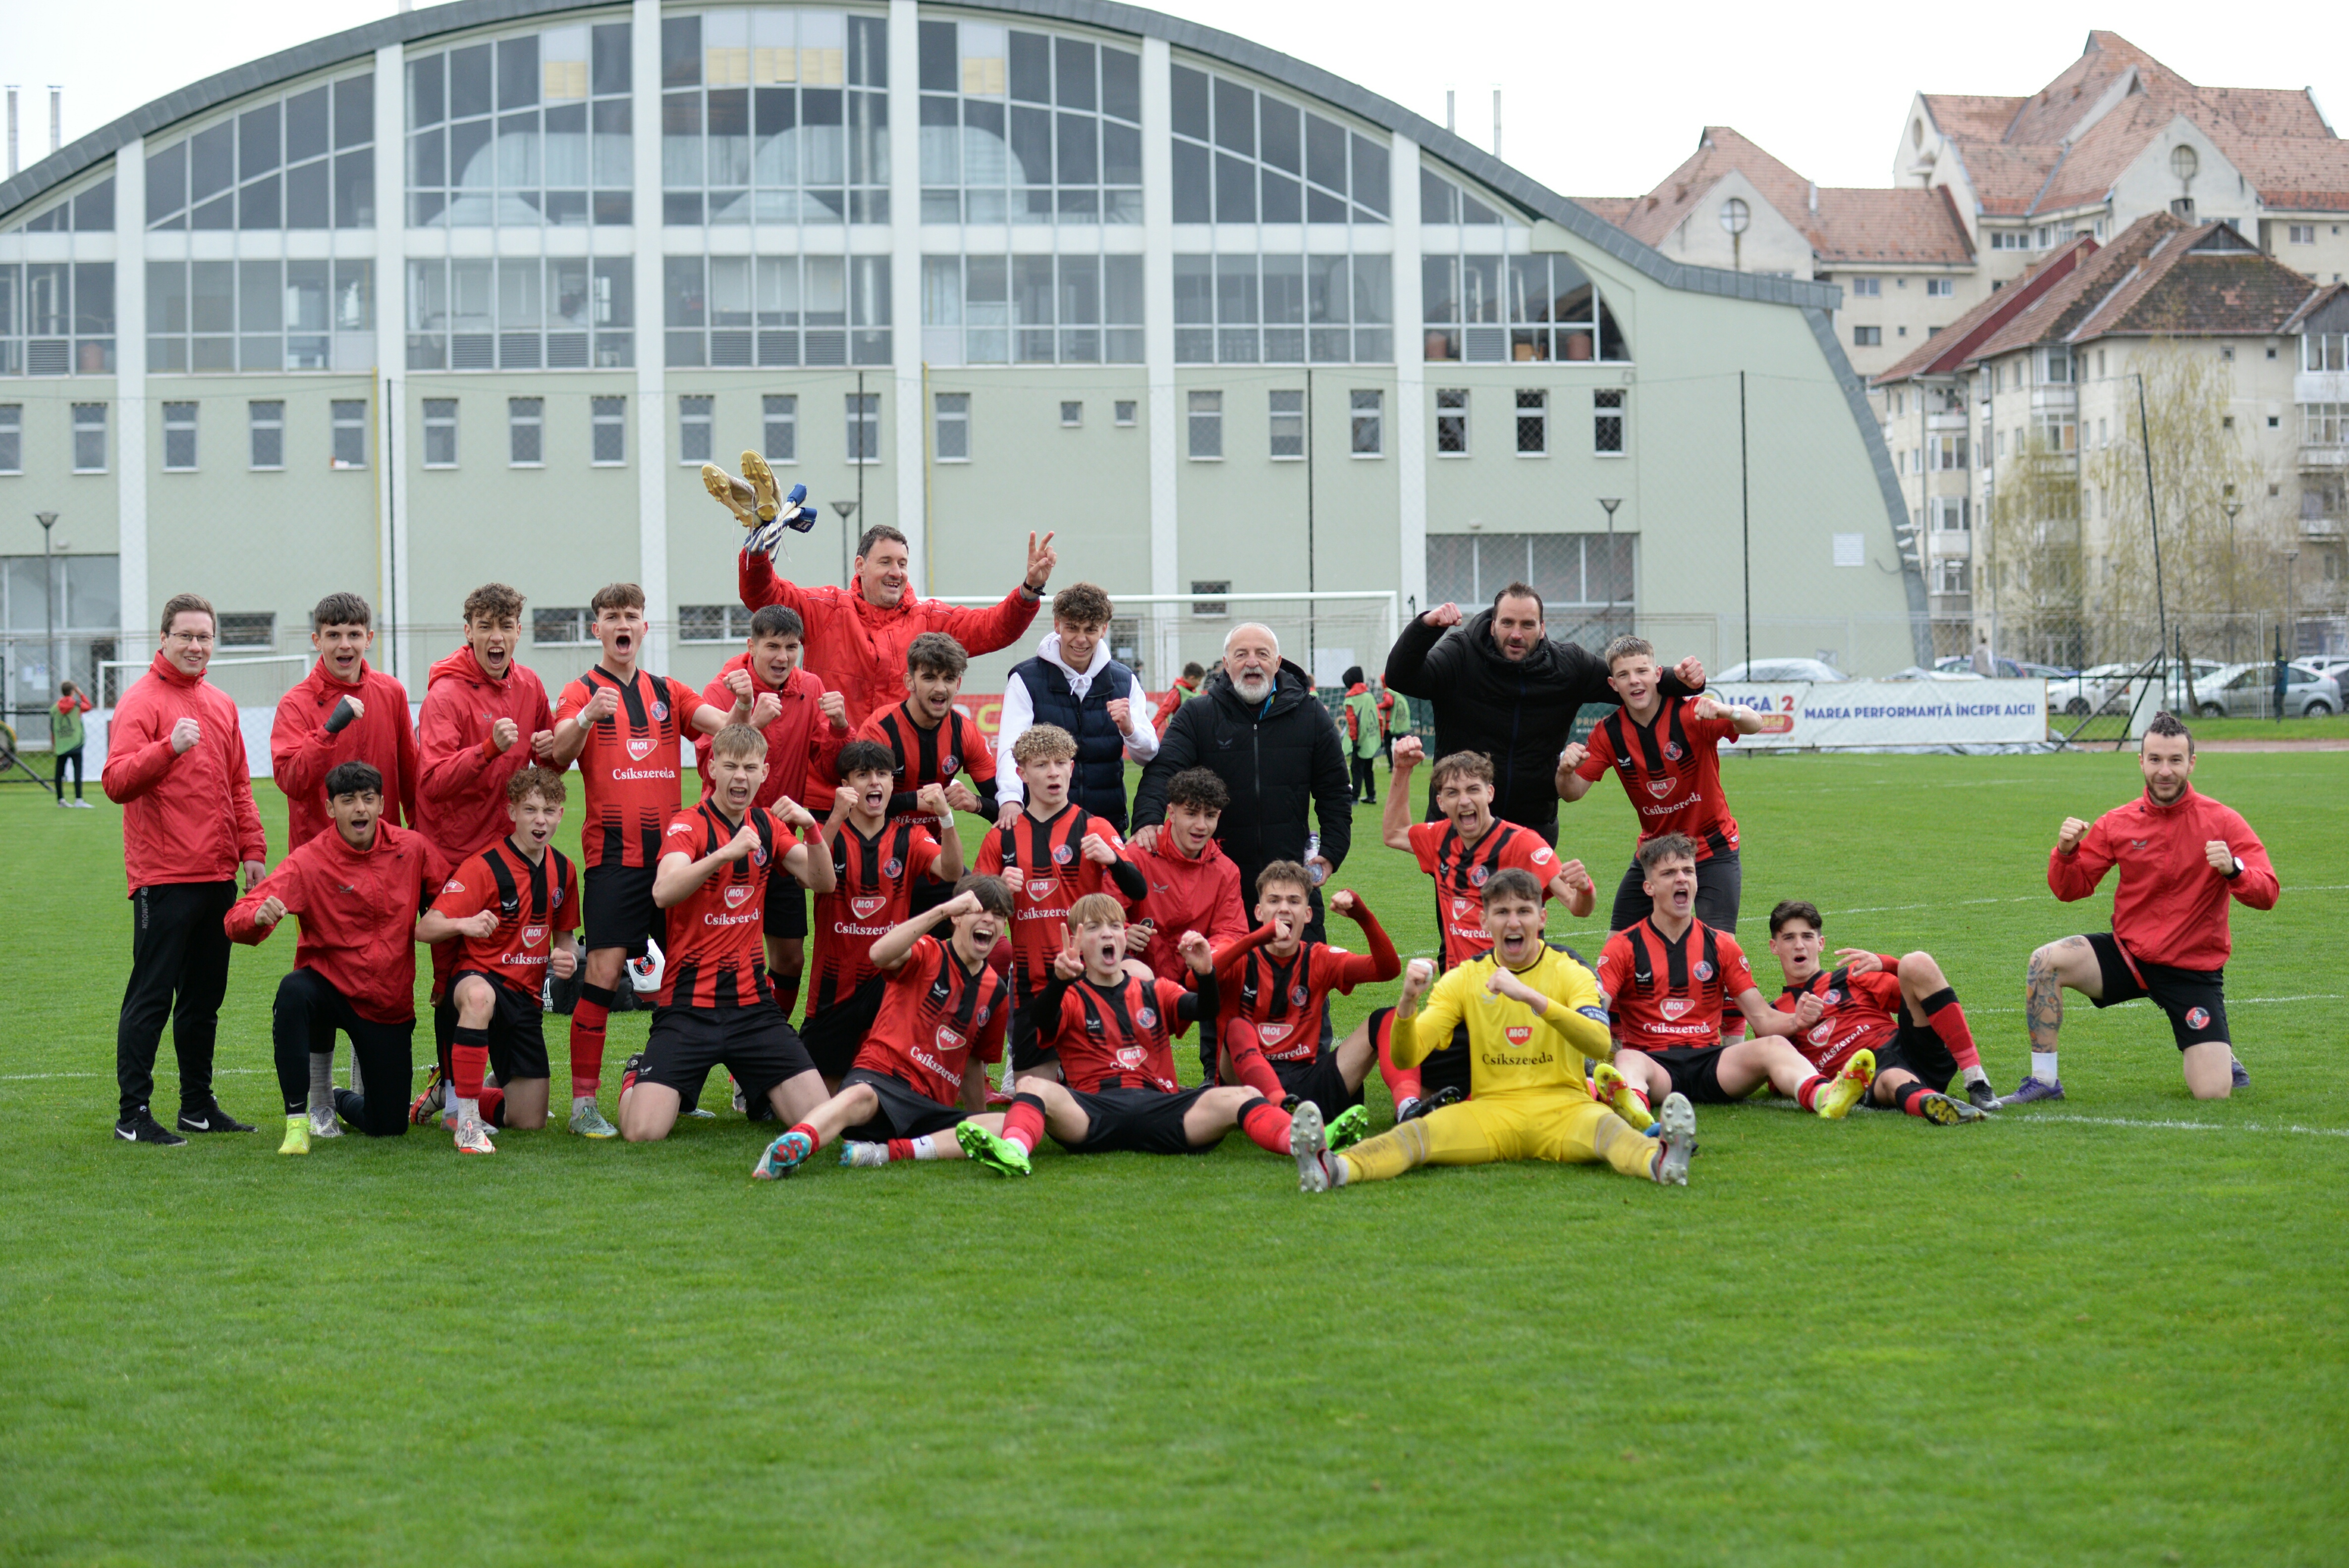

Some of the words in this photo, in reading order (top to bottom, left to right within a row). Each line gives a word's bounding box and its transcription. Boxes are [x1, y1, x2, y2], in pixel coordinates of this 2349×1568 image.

[1782, 695, 1794, 710] 2
[1805, 708, 1851, 718] MAREA
[1855, 704, 1952, 720] PERFORMANȚĂ
[1956, 702, 2001, 716] ÎNCEPE
[2005, 703, 2035, 715] AICI!
[1762, 716, 1785, 726] asa
[613, 767, 675, 780] Csíkszereda
[1642, 792, 1701, 815] Csíkszereda
[890, 815, 938, 824] síkszere
[1535, 849, 1547, 859] MOL
[728, 889, 744, 897] MOL
[705, 908, 761, 925] Csíkserd
[1017, 906, 1071, 920] Csíkszered
[526, 928, 542, 937] MOL
[1450, 923, 1493, 938] kzereda
[502, 953, 549, 965] Csíkszere
[543, 998, 553, 1007] UTH
[1666, 1002, 1684, 1010] MOL
[1262, 1026, 1280, 1035] MOL
[1509, 1028, 1528, 1037] MOL
[1643, 1023, 1711, 1034] Csíkszereda
[1812, 1025, 1828, 1040] MOL
[940, 1029, 957, 1044] MOL
[1123, 1049, 1141, 1060] MOL
[1261, 1044, 1311, 1060] szereda
[1814, 1024, 1871, 1073] Csíkszereda
[910, 1046, 961, 1087] Csíkszereda
